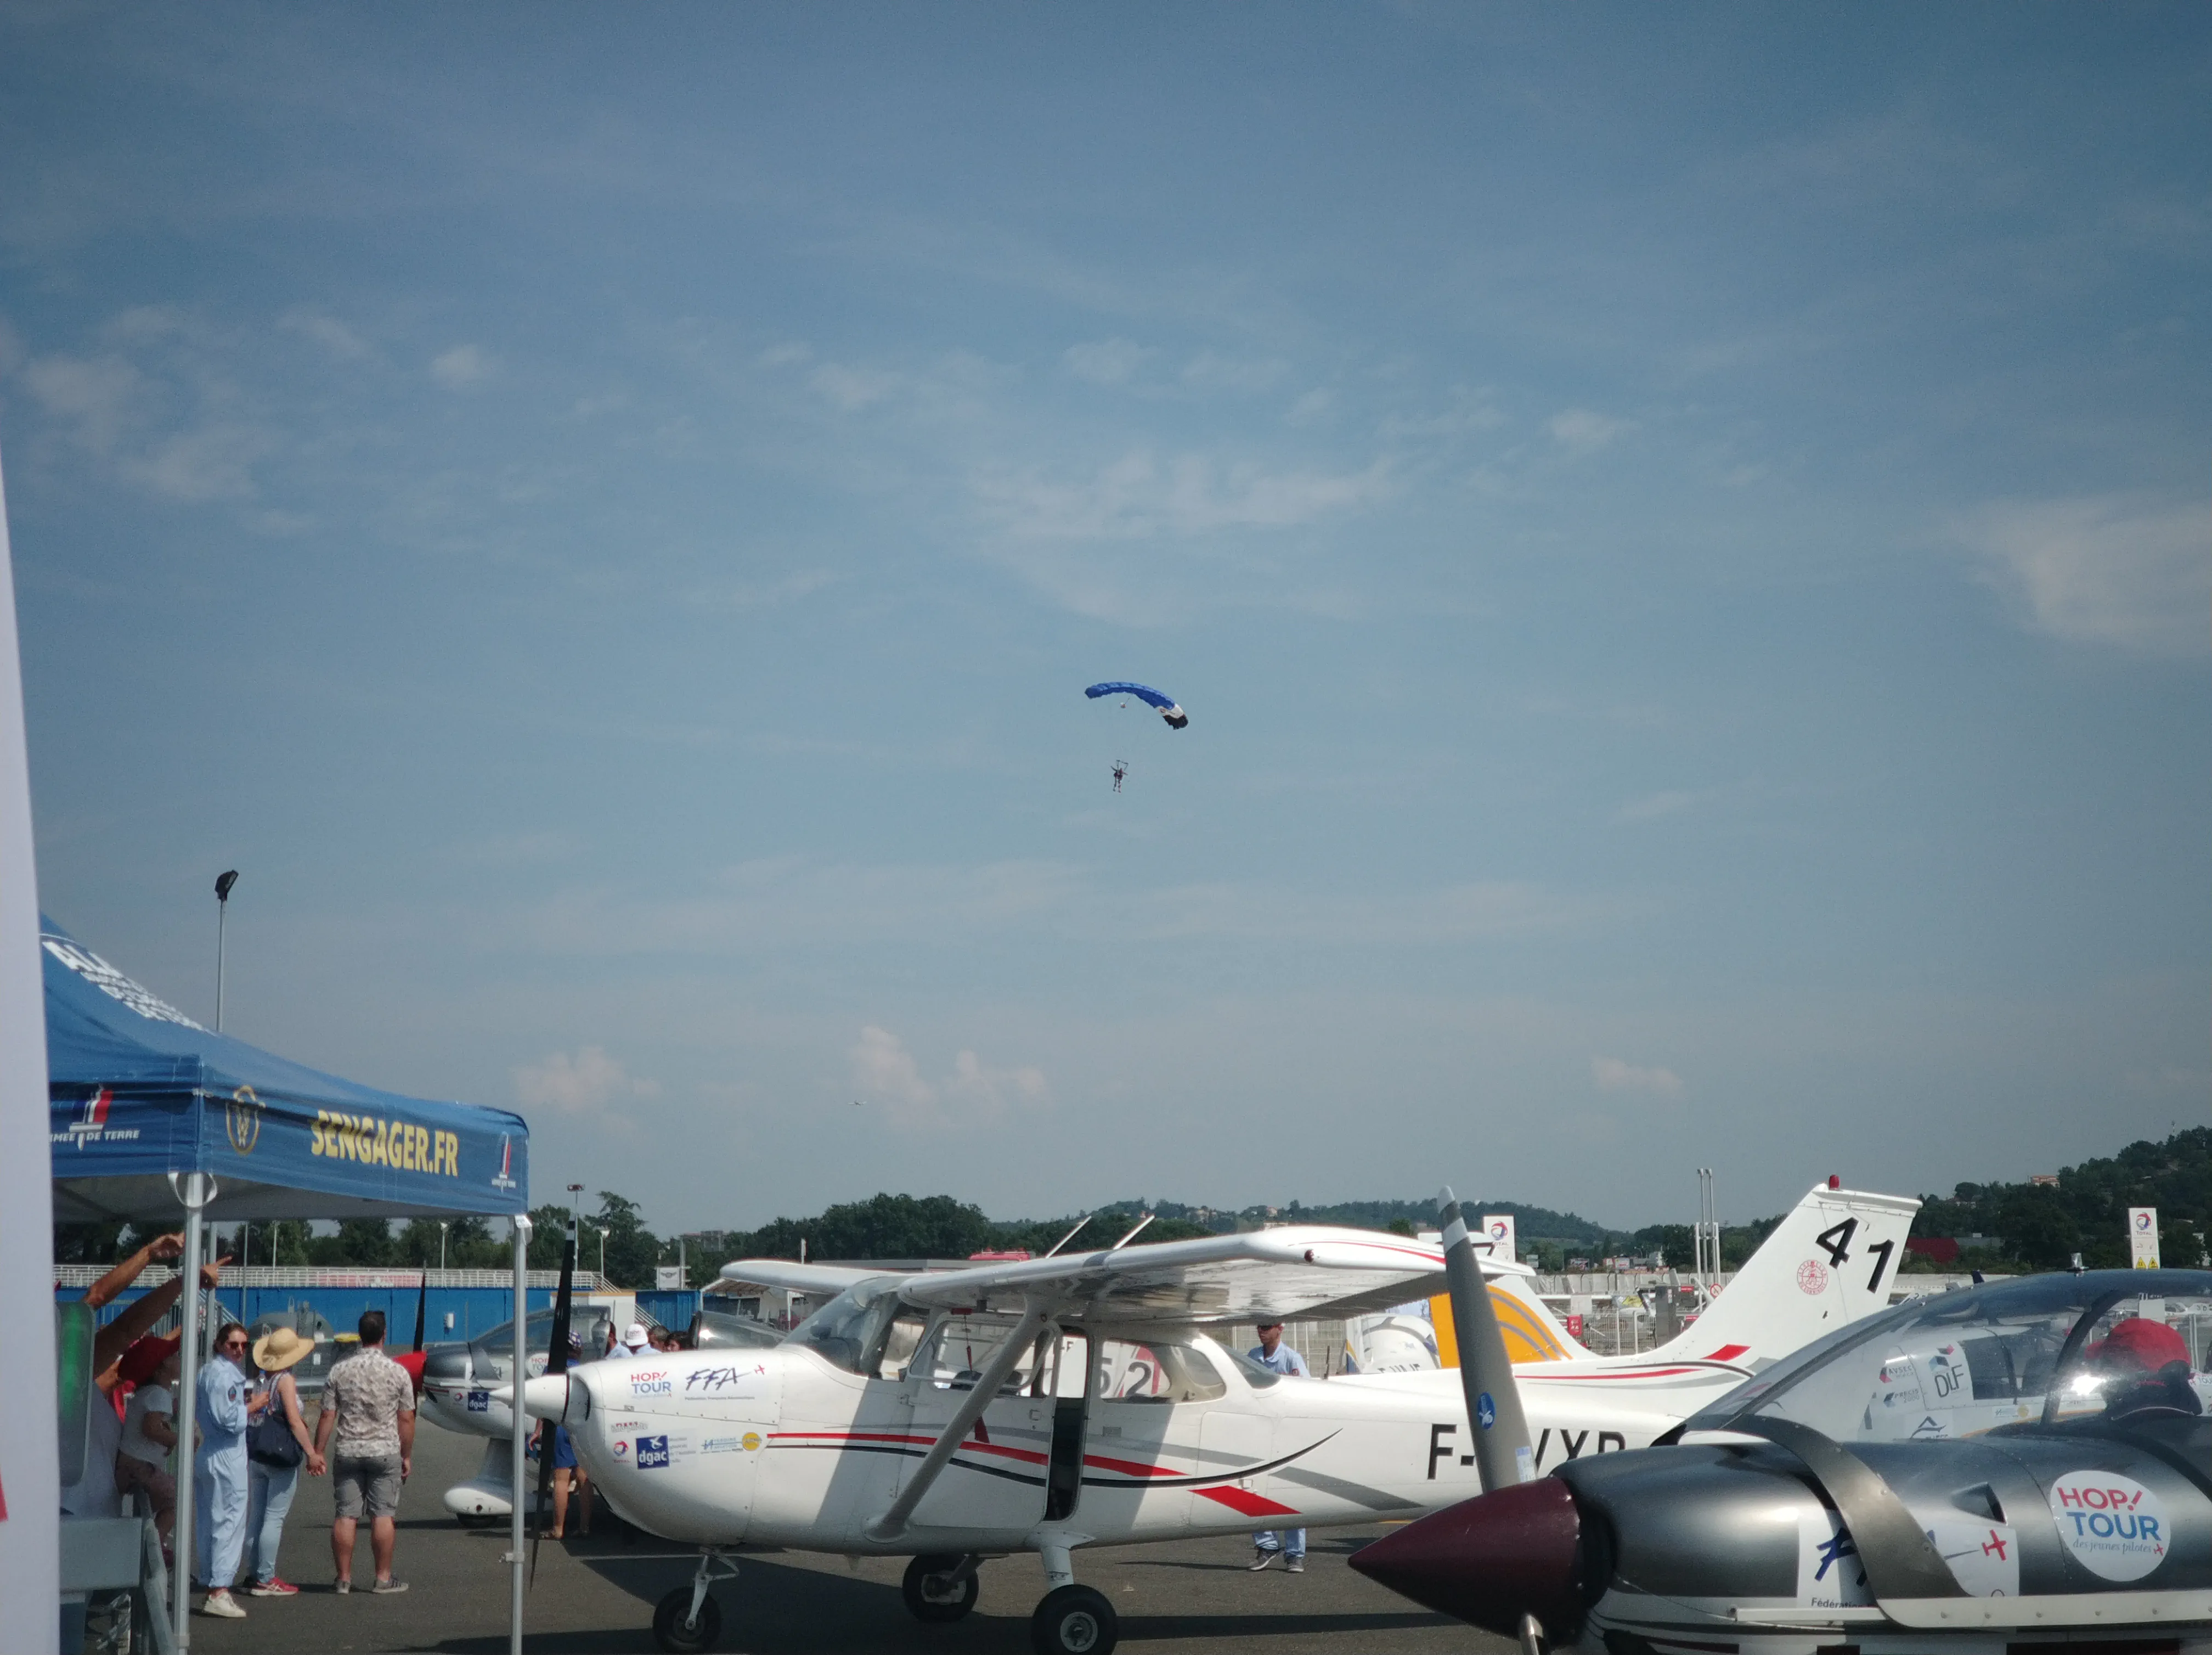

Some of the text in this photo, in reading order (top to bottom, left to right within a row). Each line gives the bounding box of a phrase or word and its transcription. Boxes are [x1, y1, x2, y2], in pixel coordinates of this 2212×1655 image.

[86, 1132, 101, 1141] DE
[104, 1129, 140, 1141] TERRE
[311, 1109, 459, 1178] SENGAGER.FR
[631, 1371, 667, 1382] HOP!
[685, 1367, 739, 1391] FFA
[631, 1381, 672, 1394] TOUR
[639, 1450, 668, 1466] dgac
[2057, 1487, 2143, 1511] HOP!
[2066, 1511, 2162, 1541] TOUR
[2073, 1539, 2152, 1555] des jeunes pilotes
